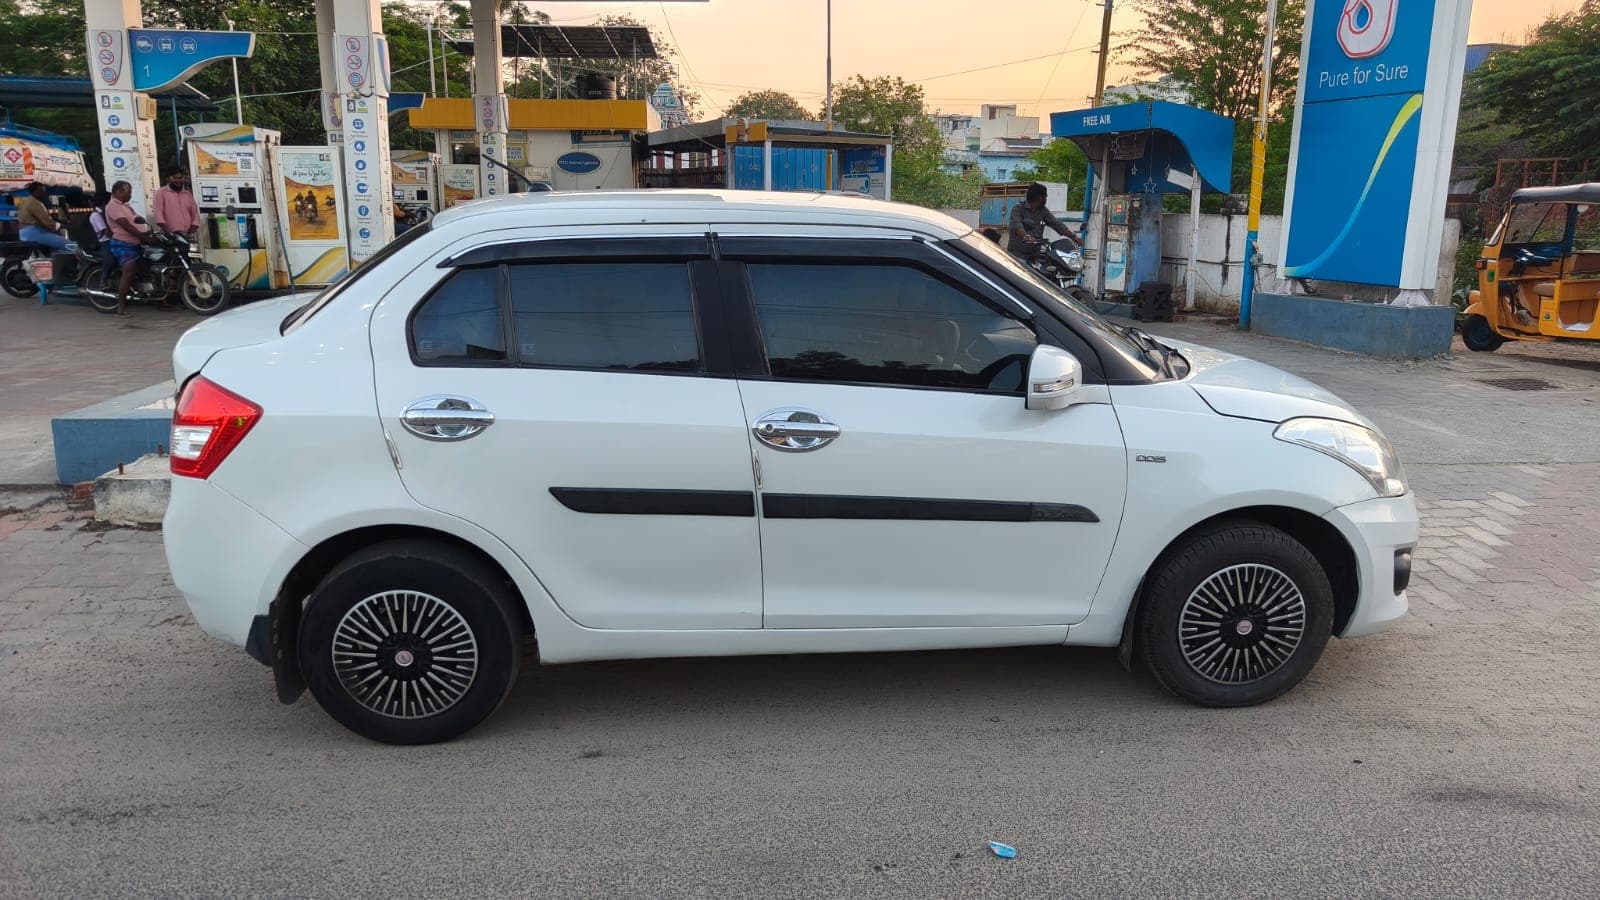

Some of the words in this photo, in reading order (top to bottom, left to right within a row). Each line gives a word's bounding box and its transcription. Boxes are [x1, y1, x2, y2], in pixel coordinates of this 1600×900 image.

[143, 64, 150, 78] 1
[1319, 71, 1349, 88] Pure
[1353, 66, 1372, 84] for
[1375, 63, 1409, 82] Sure
[1082, 115, 1099, 127] FREE
[1099, 113, 1112, 125] AIR
